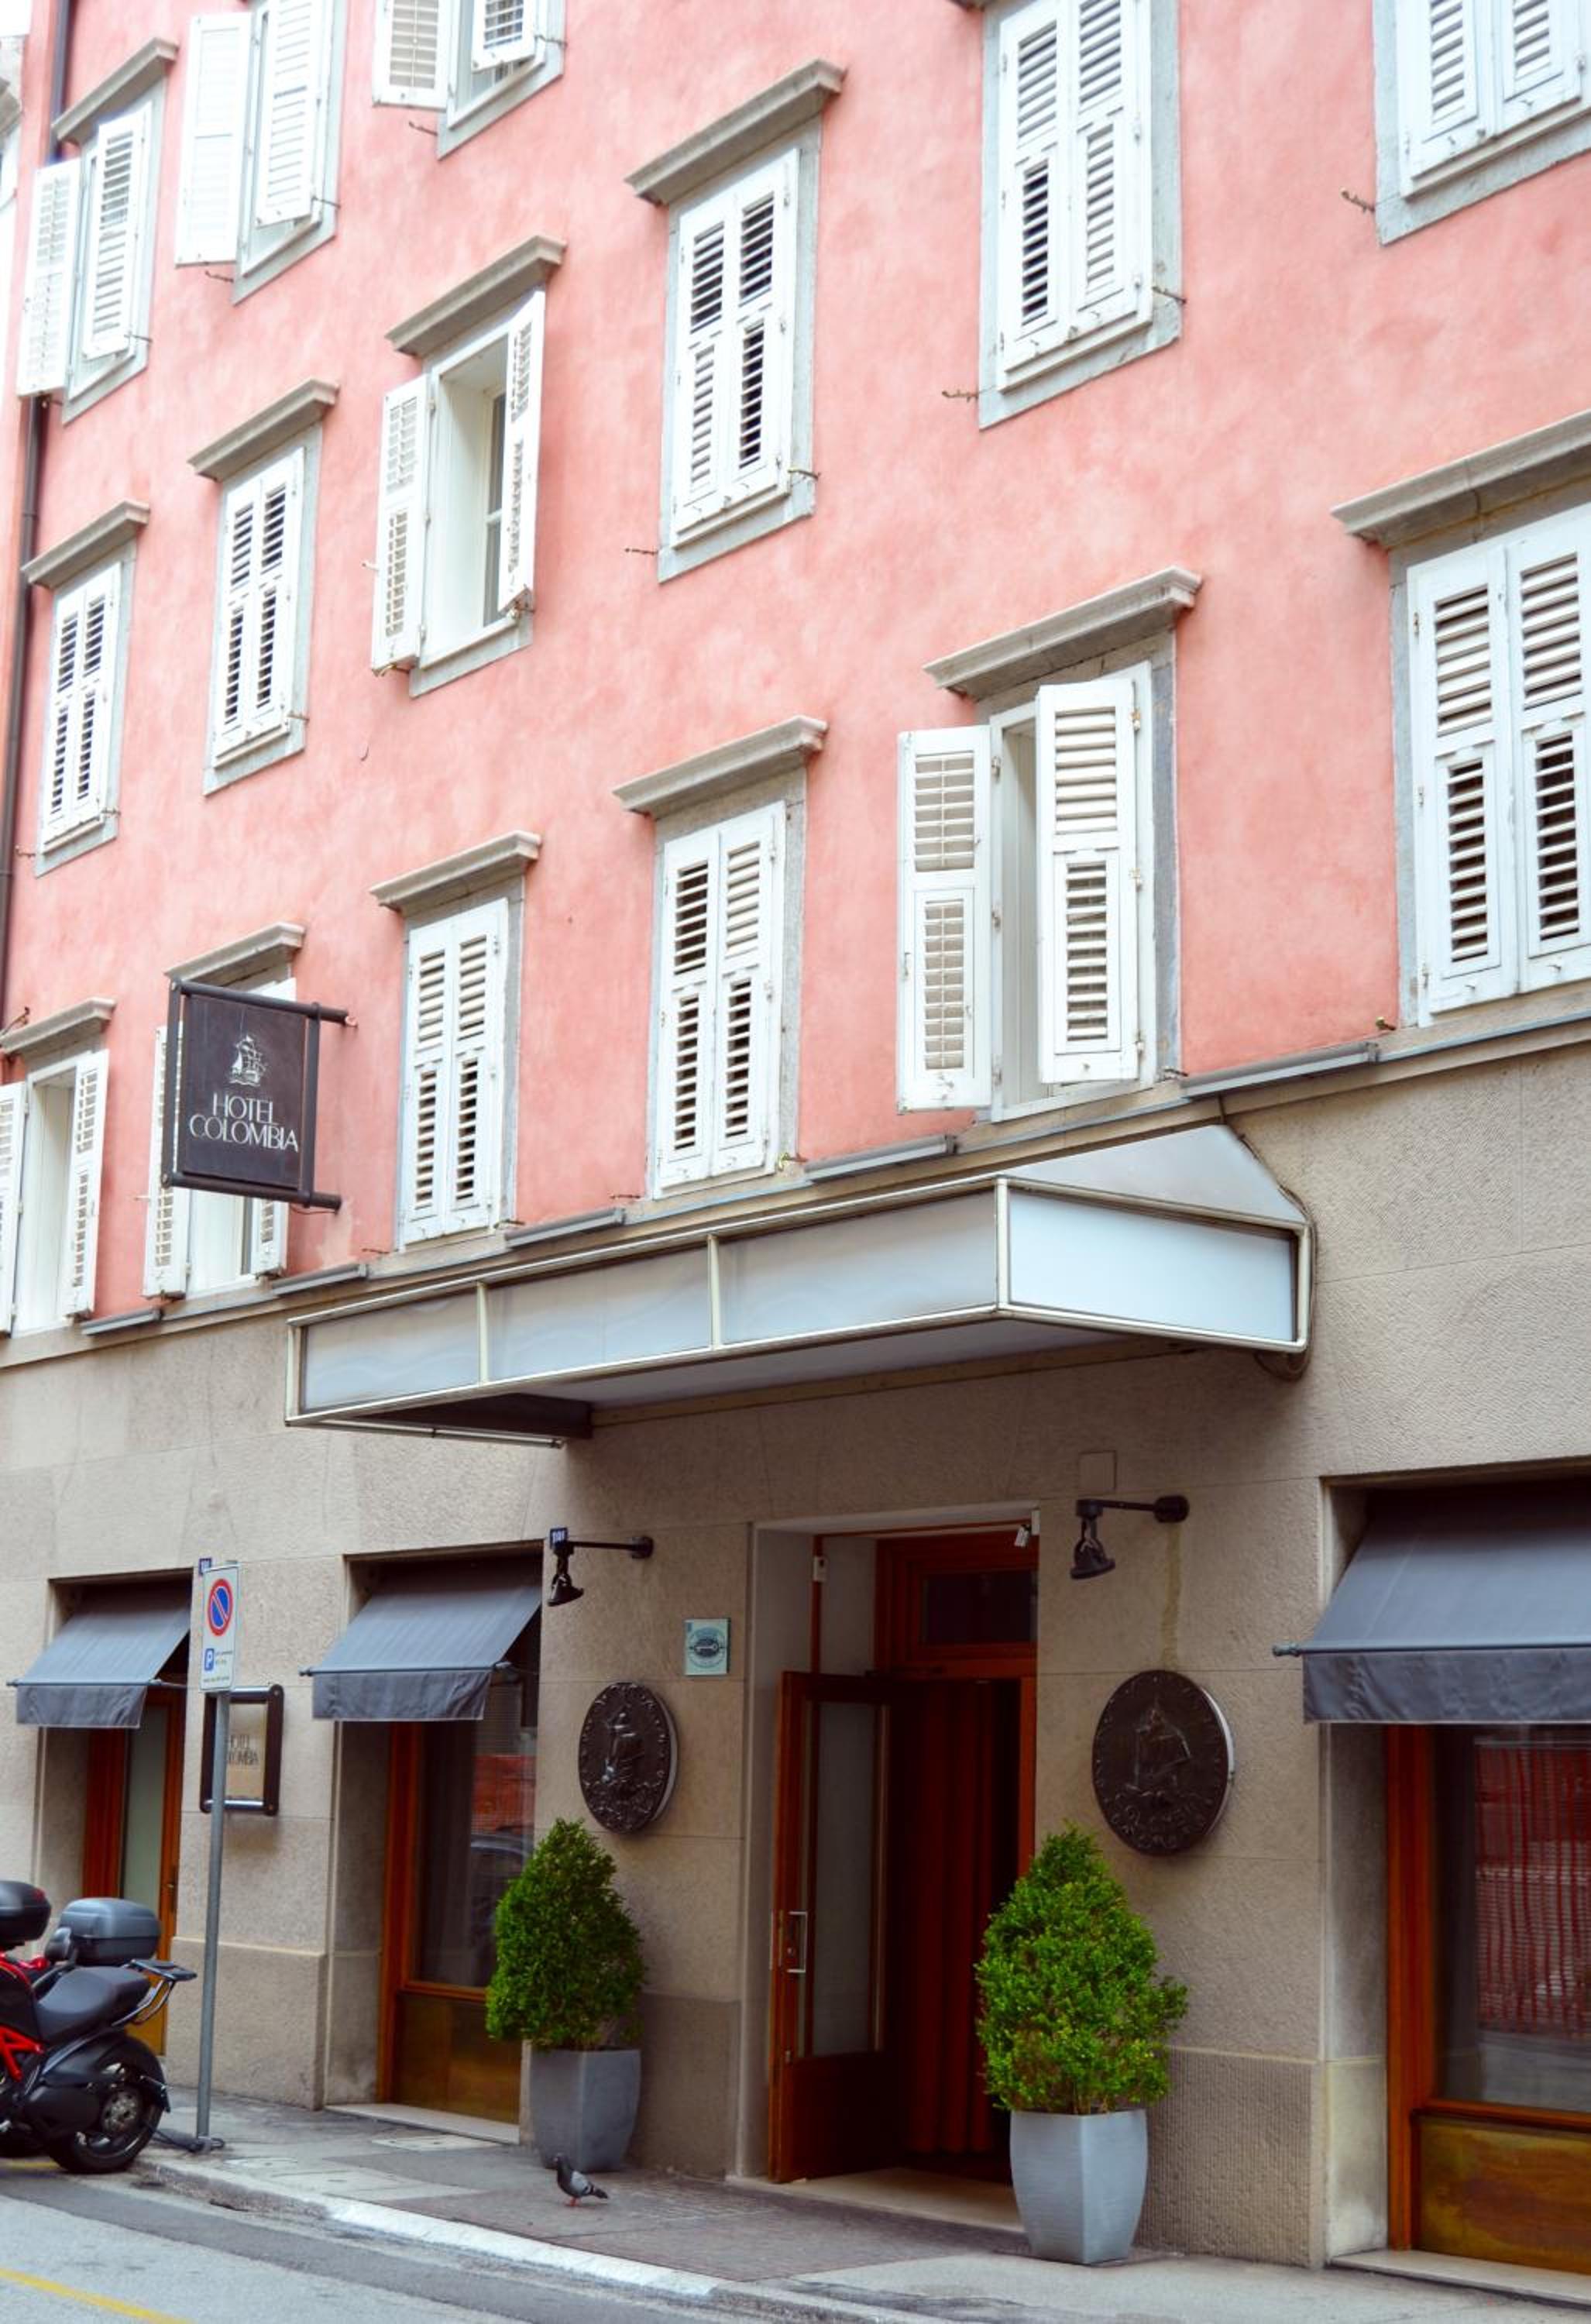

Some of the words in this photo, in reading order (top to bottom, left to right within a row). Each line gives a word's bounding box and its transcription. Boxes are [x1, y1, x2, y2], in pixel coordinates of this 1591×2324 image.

[212, 1092, 279, 1126] HOTEL
[189, 1113, 299, 1153] COLOMBIA
[206, 1650, 213, 1669] P
